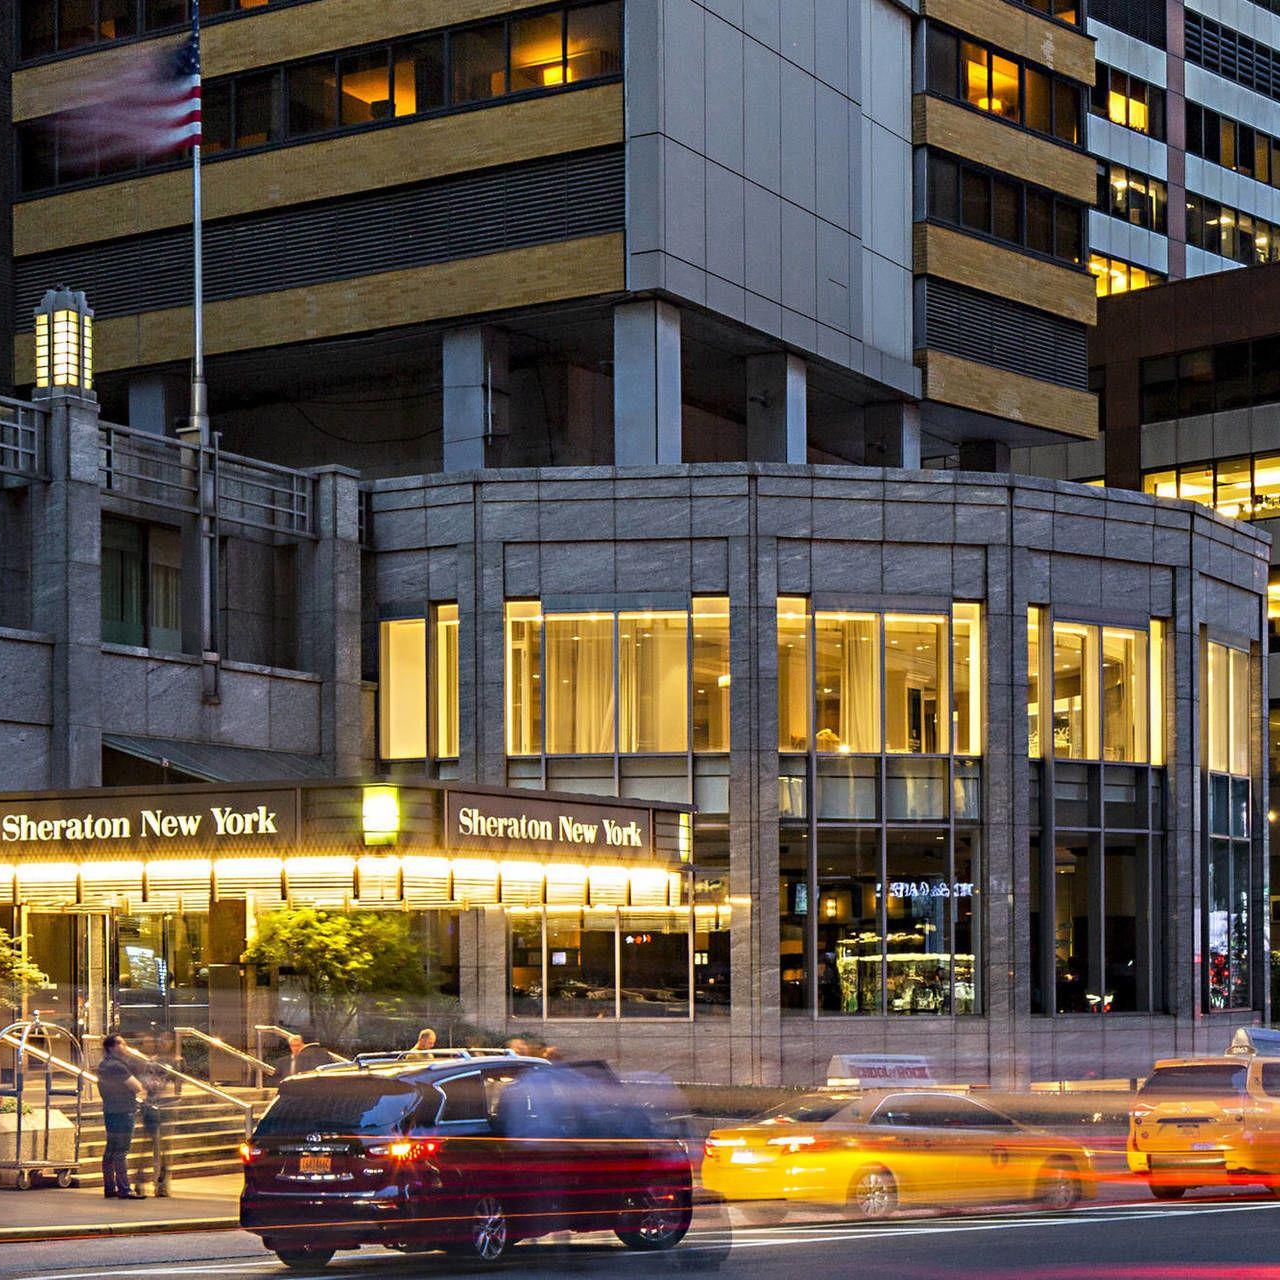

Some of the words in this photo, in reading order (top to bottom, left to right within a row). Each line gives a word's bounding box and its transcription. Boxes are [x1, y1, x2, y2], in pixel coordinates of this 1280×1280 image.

[2, 814, 131, 842] Sheraton
[141, 809, 202, 838] New
[210, 806, 278, 836] York
[459, 807, 554, 841] Sheraton
[558, 815, 599, 845] New
[602, 819, 643, 847] York
